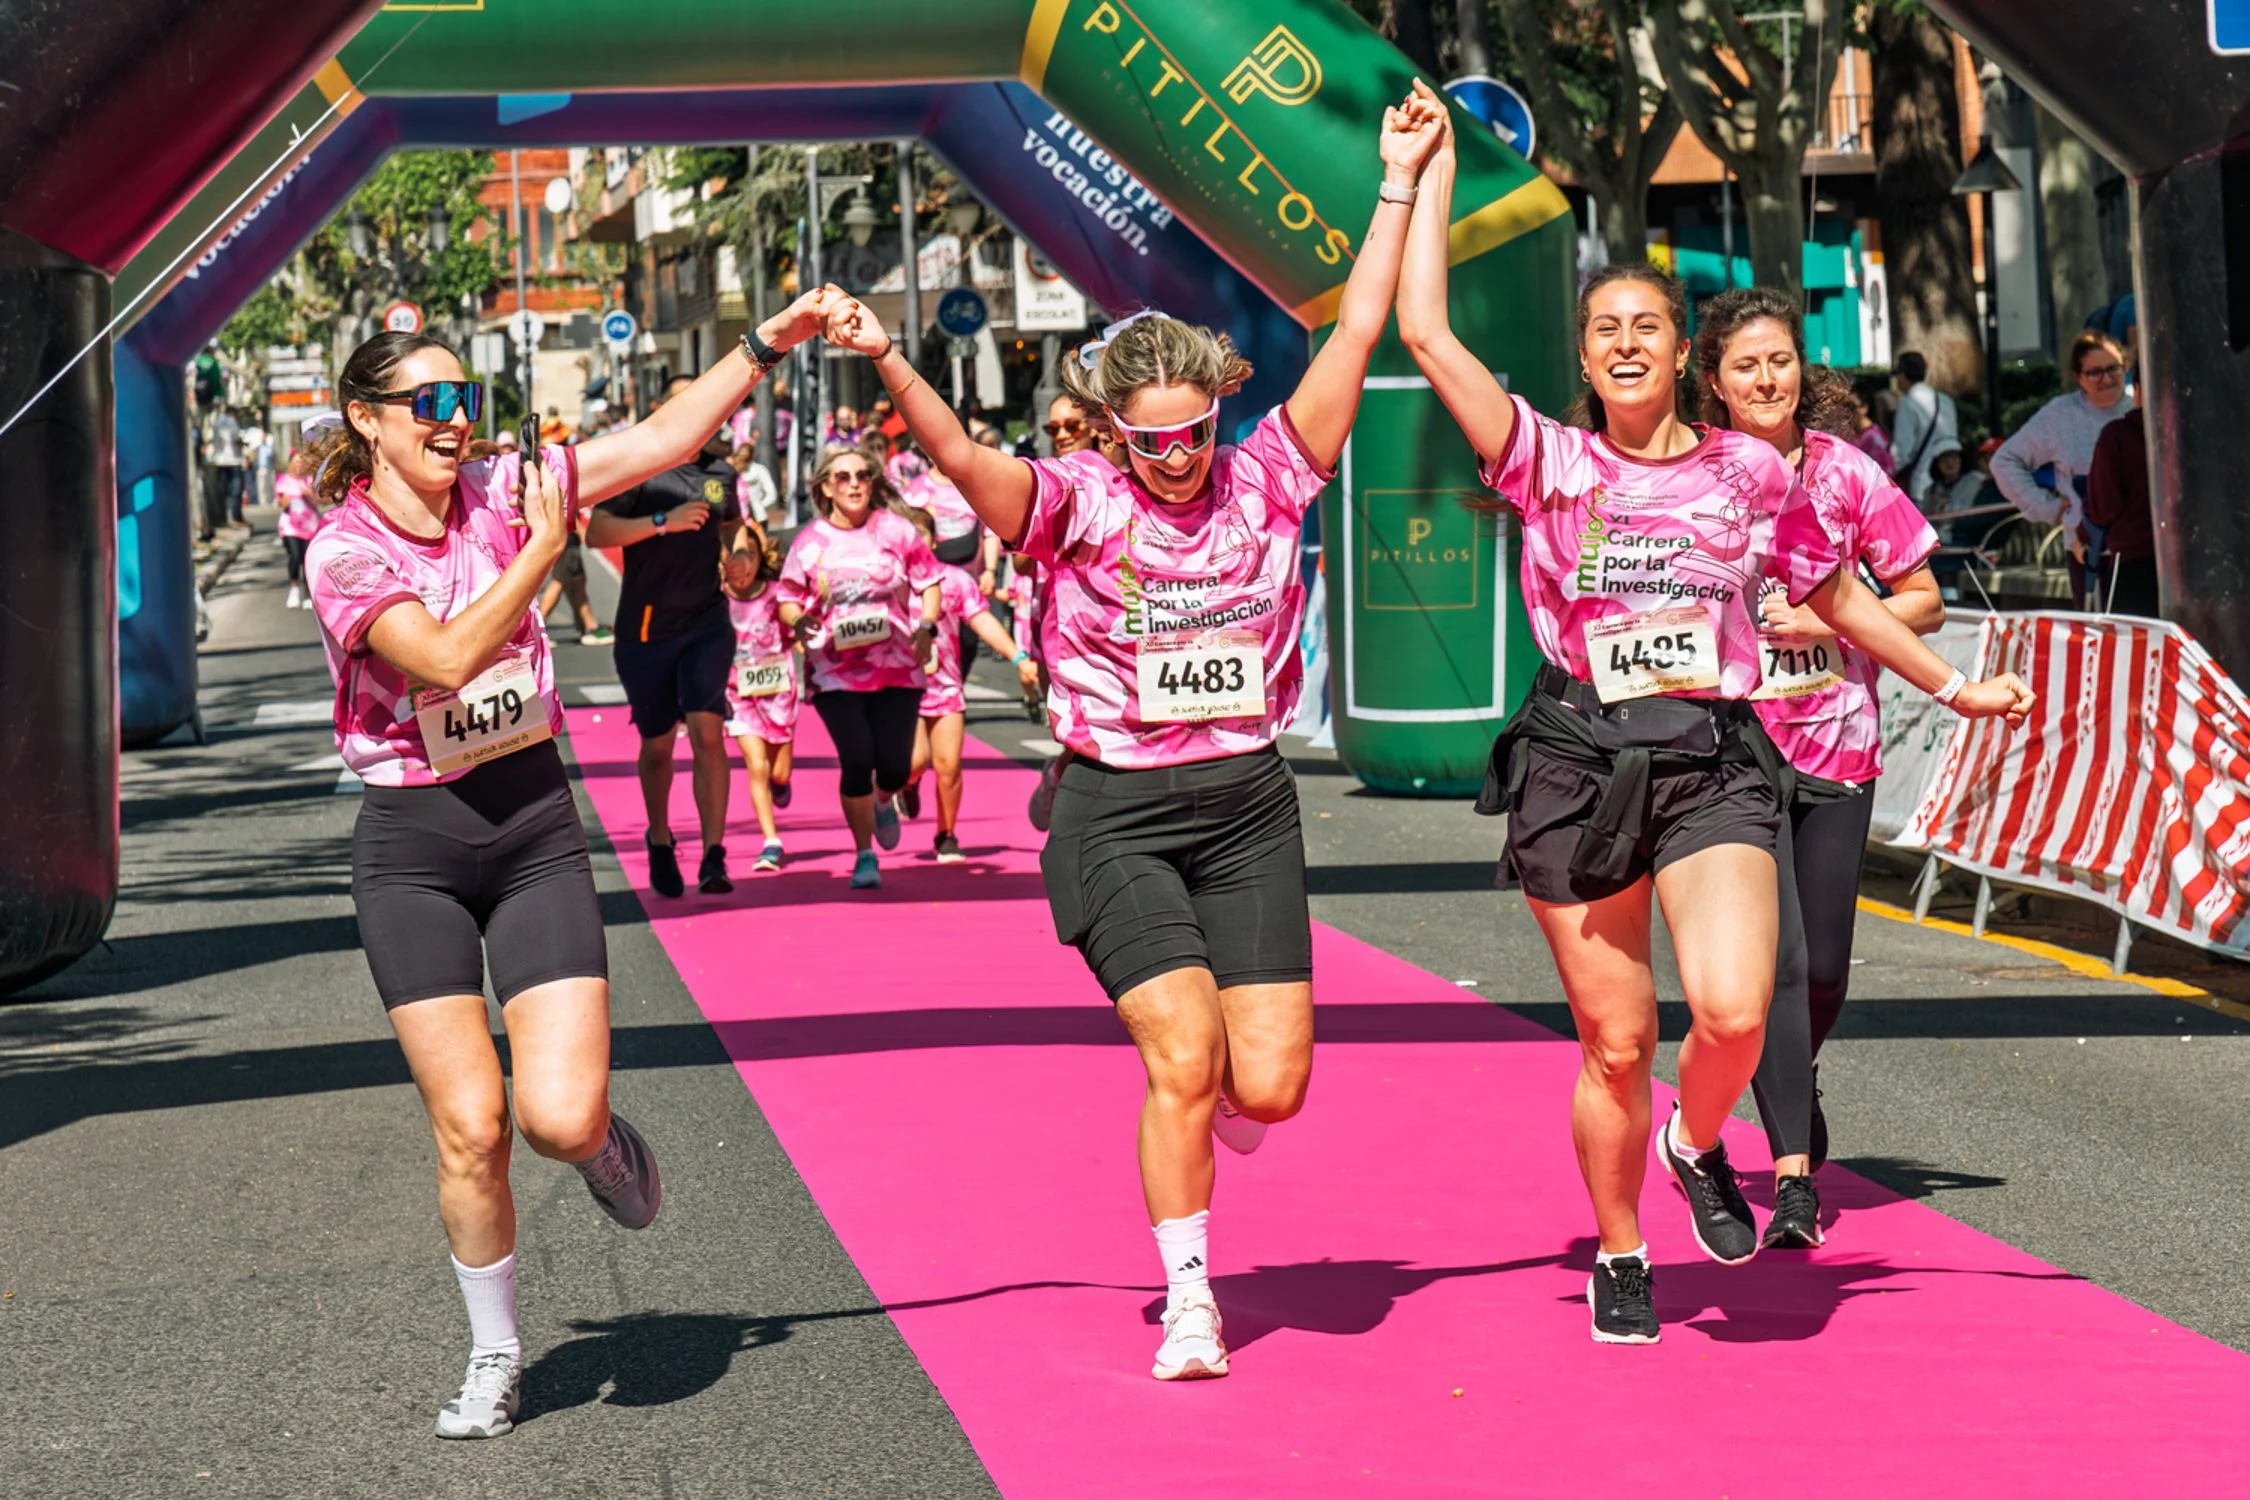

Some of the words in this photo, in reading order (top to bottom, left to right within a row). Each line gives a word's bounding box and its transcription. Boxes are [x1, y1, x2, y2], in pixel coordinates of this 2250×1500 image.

[1083, 2, 1350, 265] PITILLOS
[1044, 111, 1174, 230] nuestra
[1023, 127, 1148, 256] vocación.
[1371, 548, 1470, 563] PITILLOS
[1577, 505, 1608, 592] mujer
[1608, 529, 1693, 549] Carrera
[1603, 556, 1641, 573] por
[1646, 555, 1666, 571] la
[1141, 576, 1219, 593] Carrera
[1602, 576, 1735, 604] Investigación
[1146, 599, 1176, 615] por
[1148, 597, 1273, 633] Investigación
[1610, 632, 1697, 676] 4485
[1765, 644, 1828, 678] 7110
[745, 666, 782, 685] 9059
[1158, 657, 1245, 695] 4483
[444, 688, 523, 742] 4479
